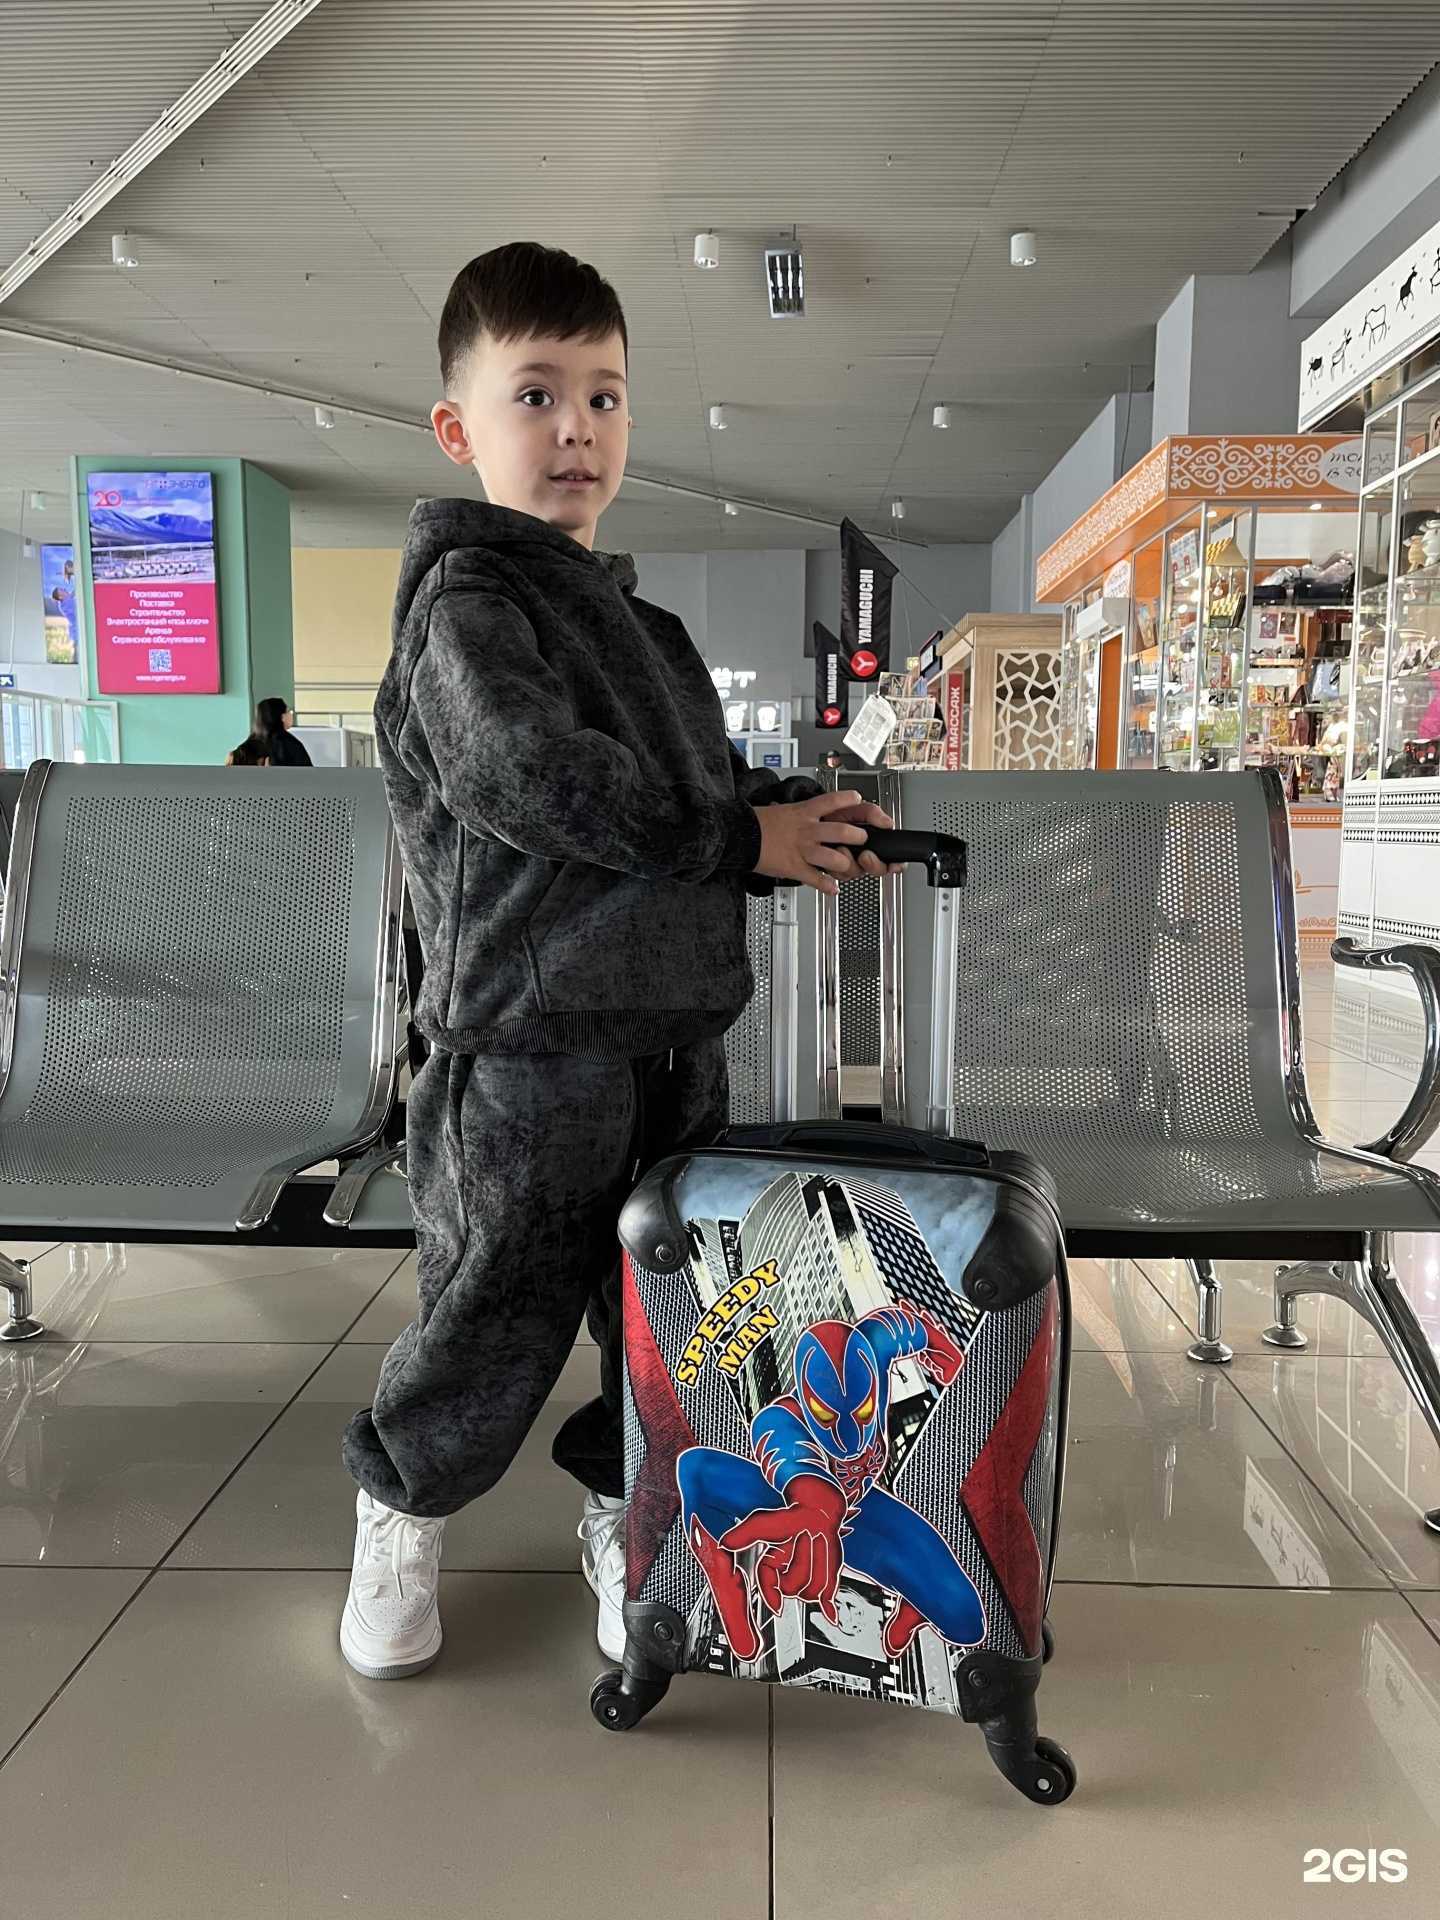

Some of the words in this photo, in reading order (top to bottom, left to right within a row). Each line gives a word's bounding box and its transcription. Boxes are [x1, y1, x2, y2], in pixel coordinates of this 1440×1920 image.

[858, 569, 874, 644] YAMAGUCHI
[827, 653, 837, 704] YAMAGUCHI
[949, 686, 961, 748] МАССАЖ
[676, 1258, 782, 1387] SPEEDY
[715, 1305, 781, 1377] MAN
